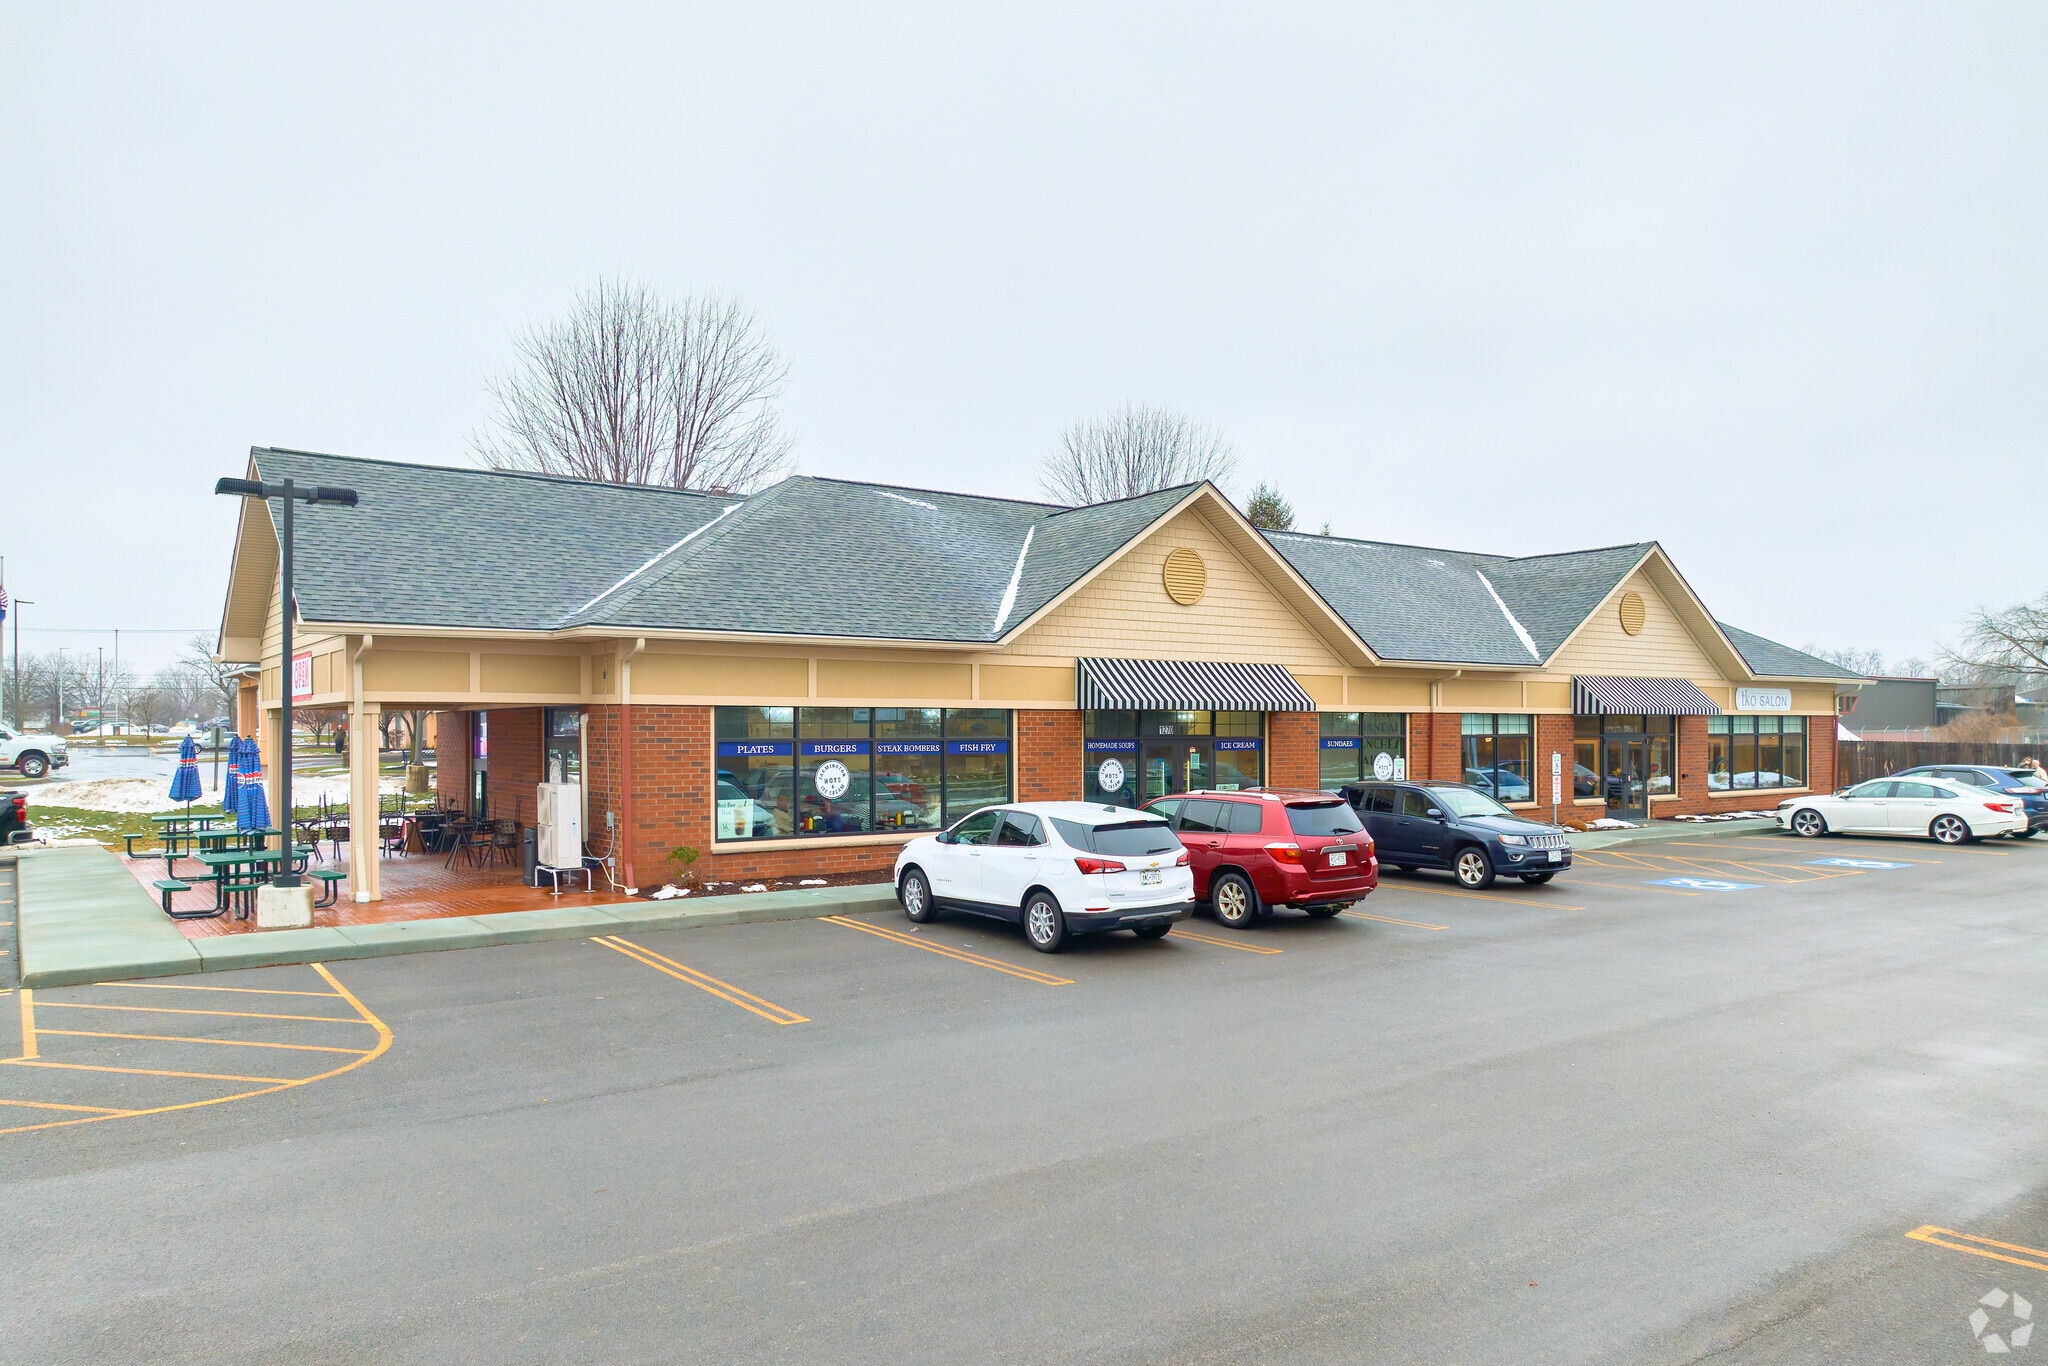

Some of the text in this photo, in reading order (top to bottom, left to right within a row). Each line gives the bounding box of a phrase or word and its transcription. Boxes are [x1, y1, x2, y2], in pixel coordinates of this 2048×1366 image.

[1760, 695, 1787, 707] SALON
[814, 744, 857, 753] BURGERS
[877, 744, 940, 753] STEAK BOMBERS
[960, 743, 997, 752] FISH FRY
[1232, 741, 1255, 749] CREAM
[1327, 740, 1353, 748] SUNDAES
[737, 745, 774, 754] PLATES
[818, 764, 846, 780] FARMINGTON
[829, 784, 845, 795] CREAM
